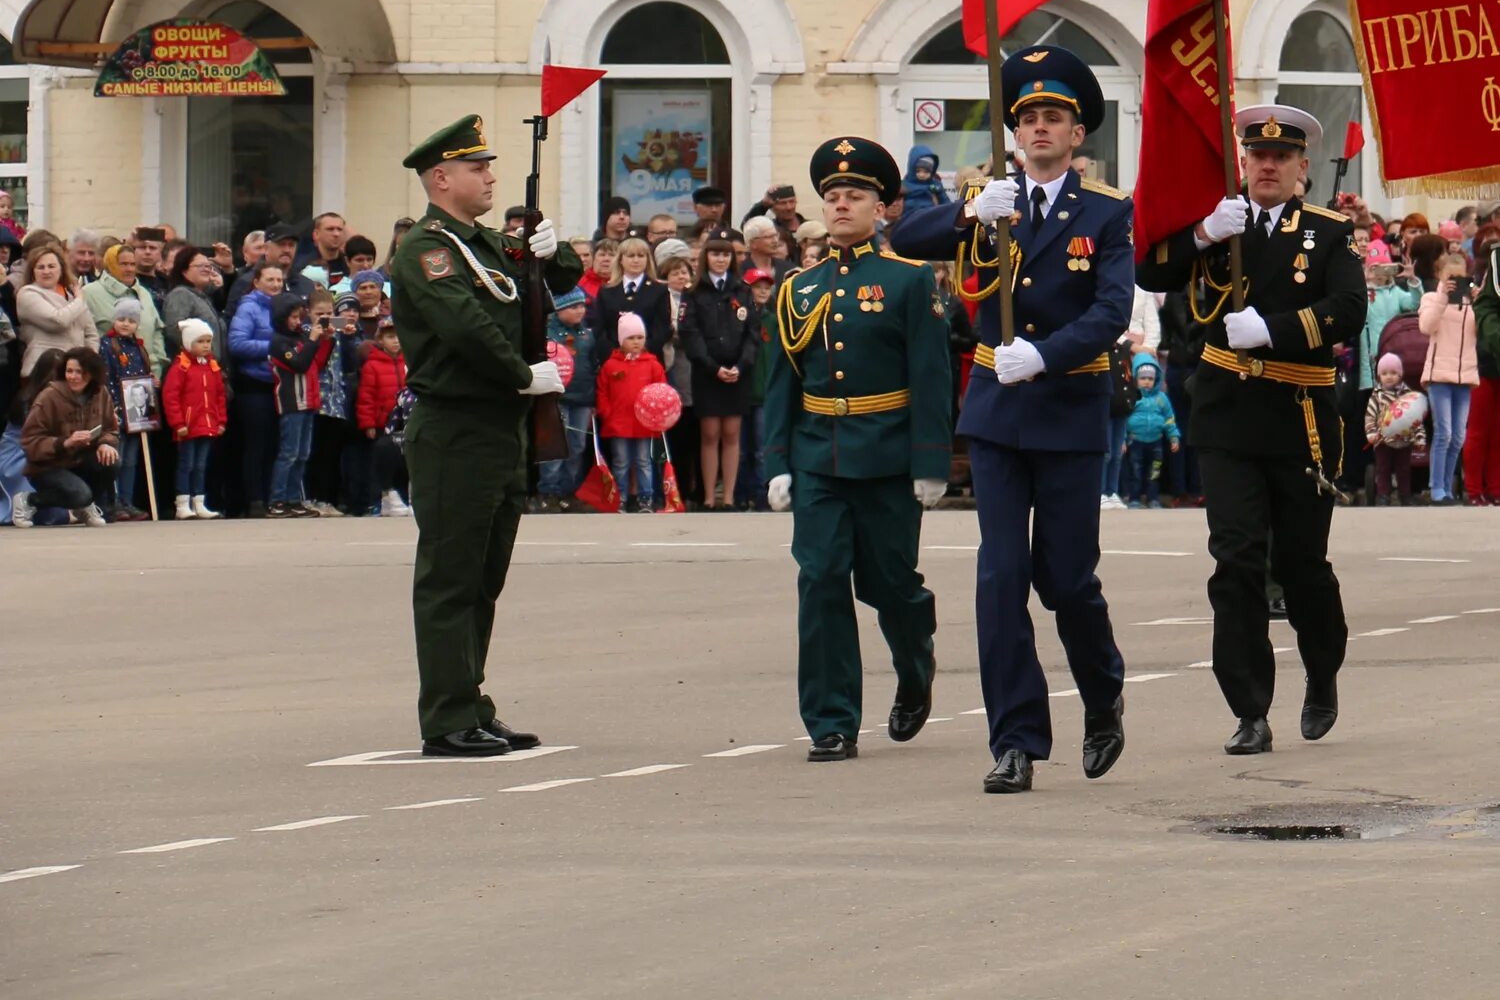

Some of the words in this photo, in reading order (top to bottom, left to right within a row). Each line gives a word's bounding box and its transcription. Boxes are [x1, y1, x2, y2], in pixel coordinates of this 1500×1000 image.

[154, 28, 226, 43] ОВОЩИ-
[154, 45, 228, 59] ФРУКТЫ
[180, 67, 197, 79] до
[103, 83, 159, 95] САМЫЕ
[163, 82, 223, 95] НИЗКИЕ
[227, 81, 272, 95] ЦЕНЫ
[630, 169, 652, 195] 9
[651, 178, 692, 191] МАЯ
